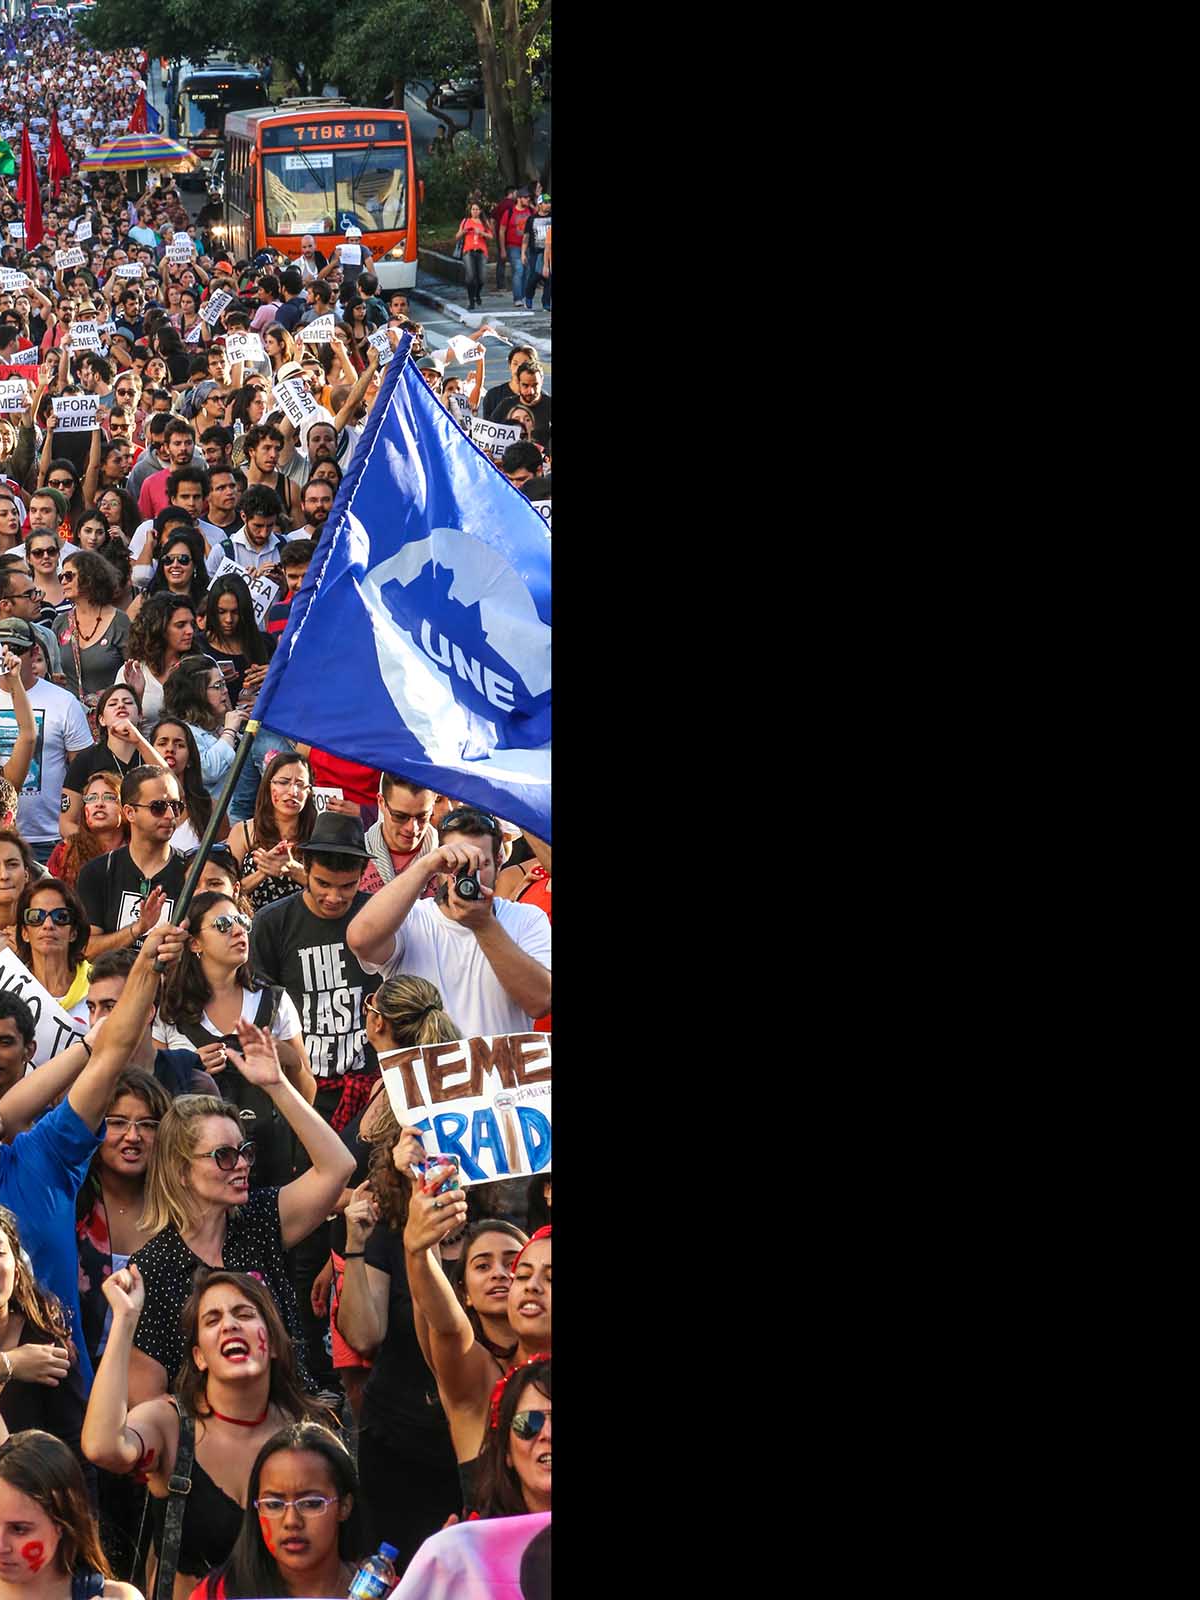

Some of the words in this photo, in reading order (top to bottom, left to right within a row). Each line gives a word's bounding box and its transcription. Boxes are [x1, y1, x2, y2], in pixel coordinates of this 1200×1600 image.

[55, 415, 97, 428] TEMER
[56, 399, 97, 411] #FORA
[276, 385, 303, 424] TEMER
[473, 423, 517, 441] #FORA
[420, 618, 516, 712] UNE
[298, 943, 348, 991] THE
[302, 986, 363, 1034] LAST
[304, 1034, 335, 1078] OF
[336, 1029, 368, 1075] US
[380, 1034, 552, 1110] TEME
